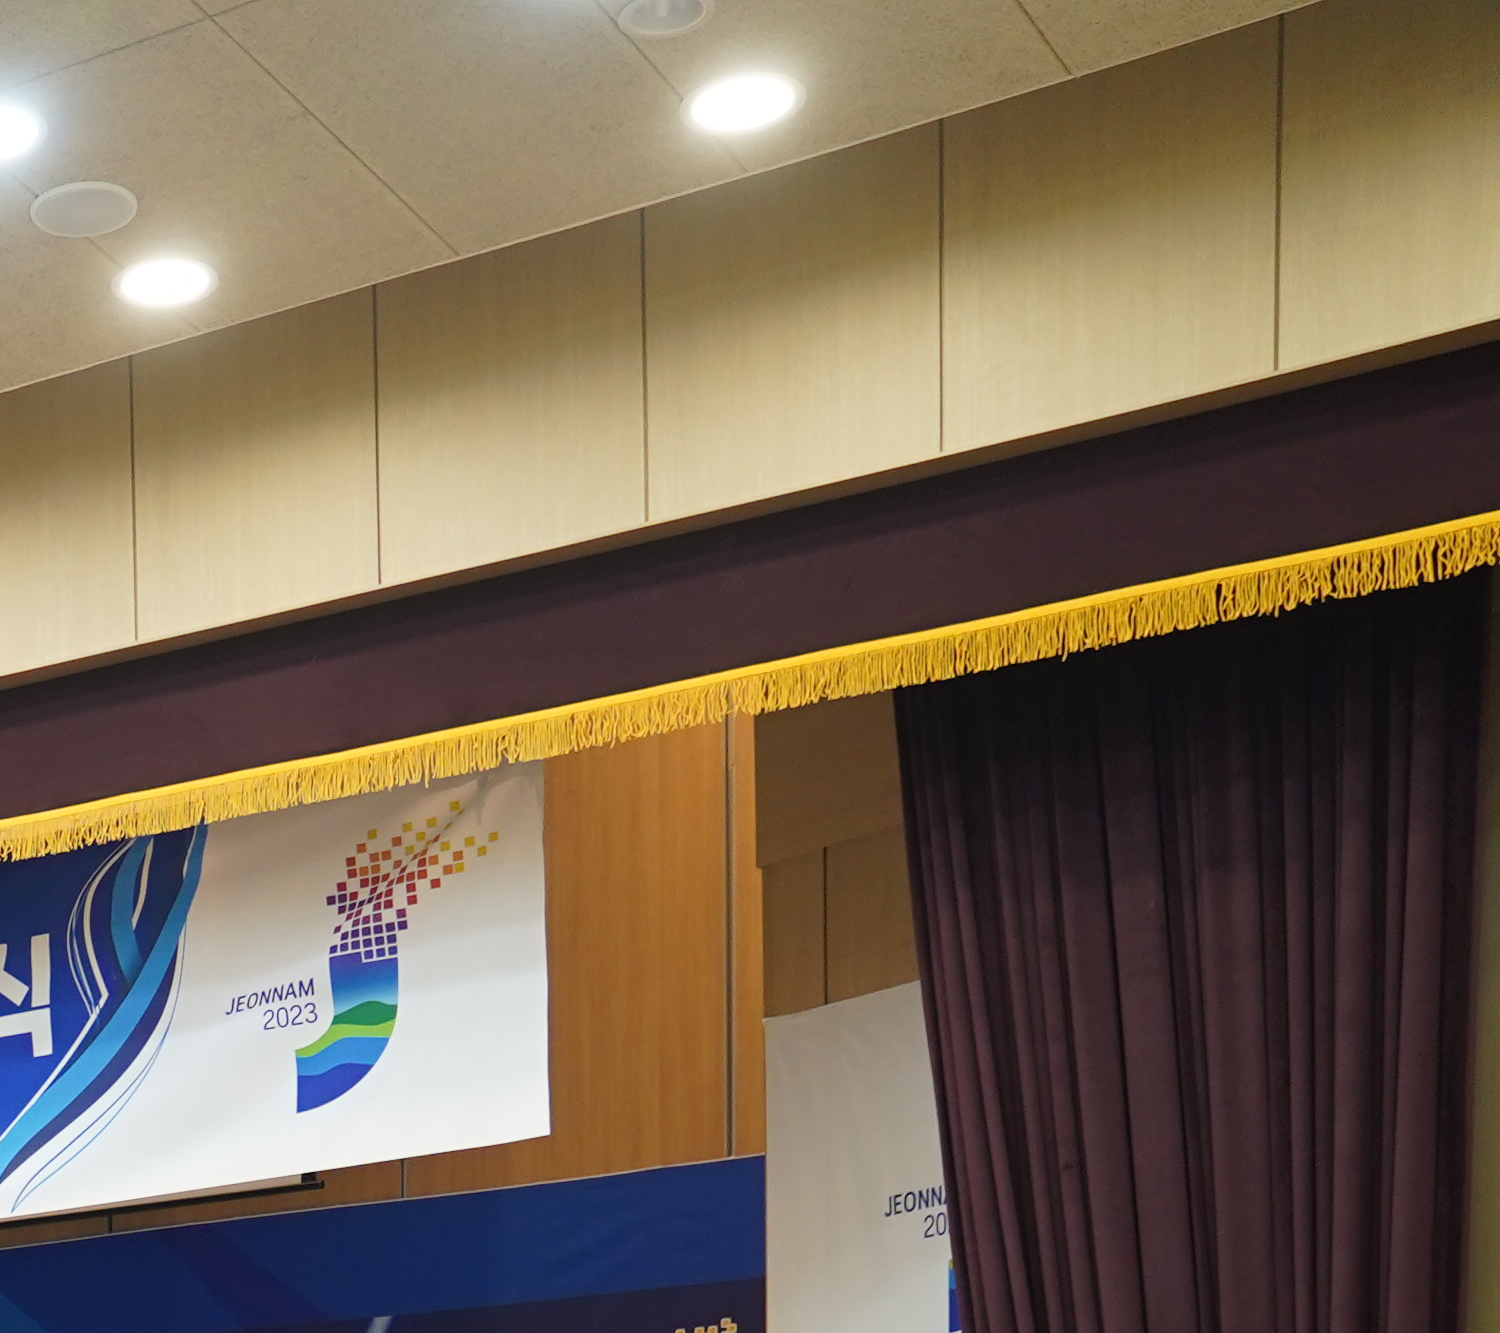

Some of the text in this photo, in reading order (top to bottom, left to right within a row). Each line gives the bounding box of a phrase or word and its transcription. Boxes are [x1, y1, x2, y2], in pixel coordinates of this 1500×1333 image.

[225, 977, 315, 1017] JEONNAM
[261, 1003, 317, 1031] 2023
[924, 1210, 950, 1239] 20
